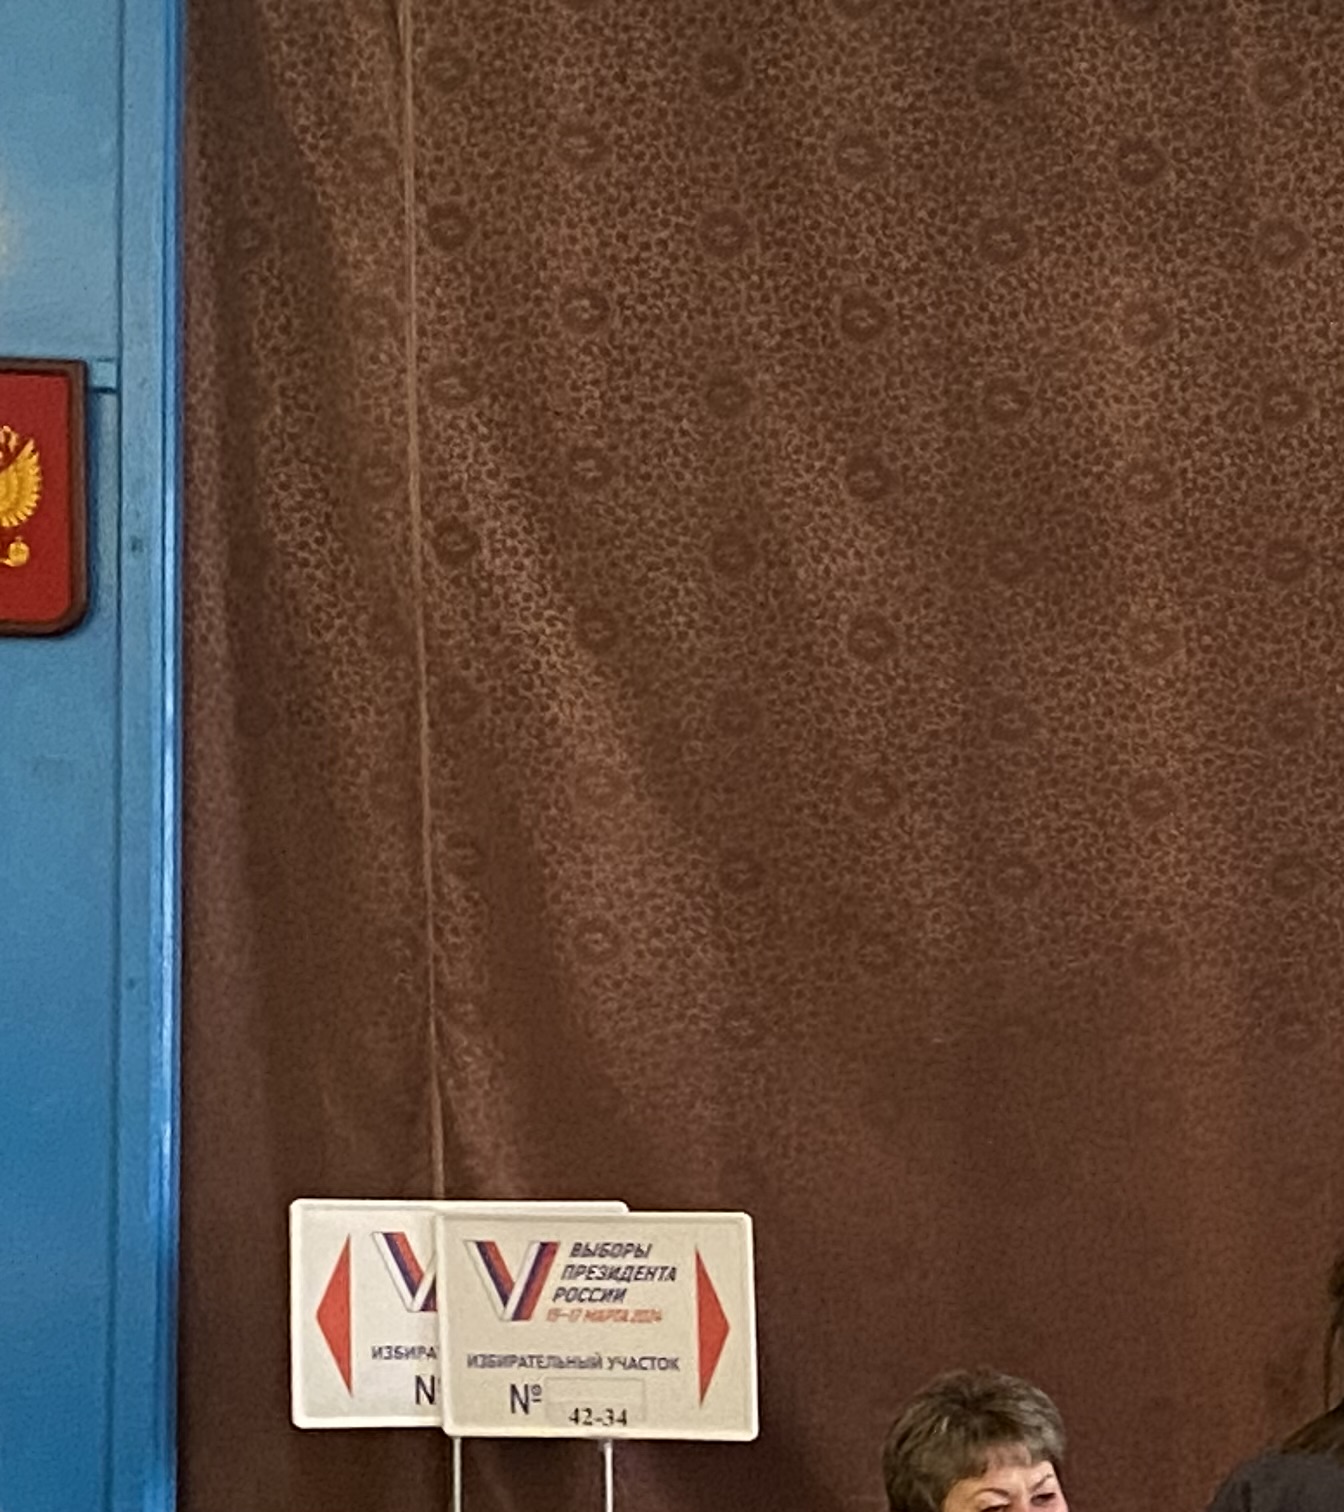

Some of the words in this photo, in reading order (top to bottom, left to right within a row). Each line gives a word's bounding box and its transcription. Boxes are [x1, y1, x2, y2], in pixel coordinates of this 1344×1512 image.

[569, 1242, 653, 1259] ВЫБОРЫ
[560, 1264, 677, 1283] ПРЕЗИДЕНТА
[552, 1286, 628, 1303] РОССИИ
[466, 1352, 604, 1370] ИЗБИРАТЕЛЬНЫЙ
[606, 1356, 681, 1371] УЧАСТОК
[568, 1407, 628, 1426] 42-34
